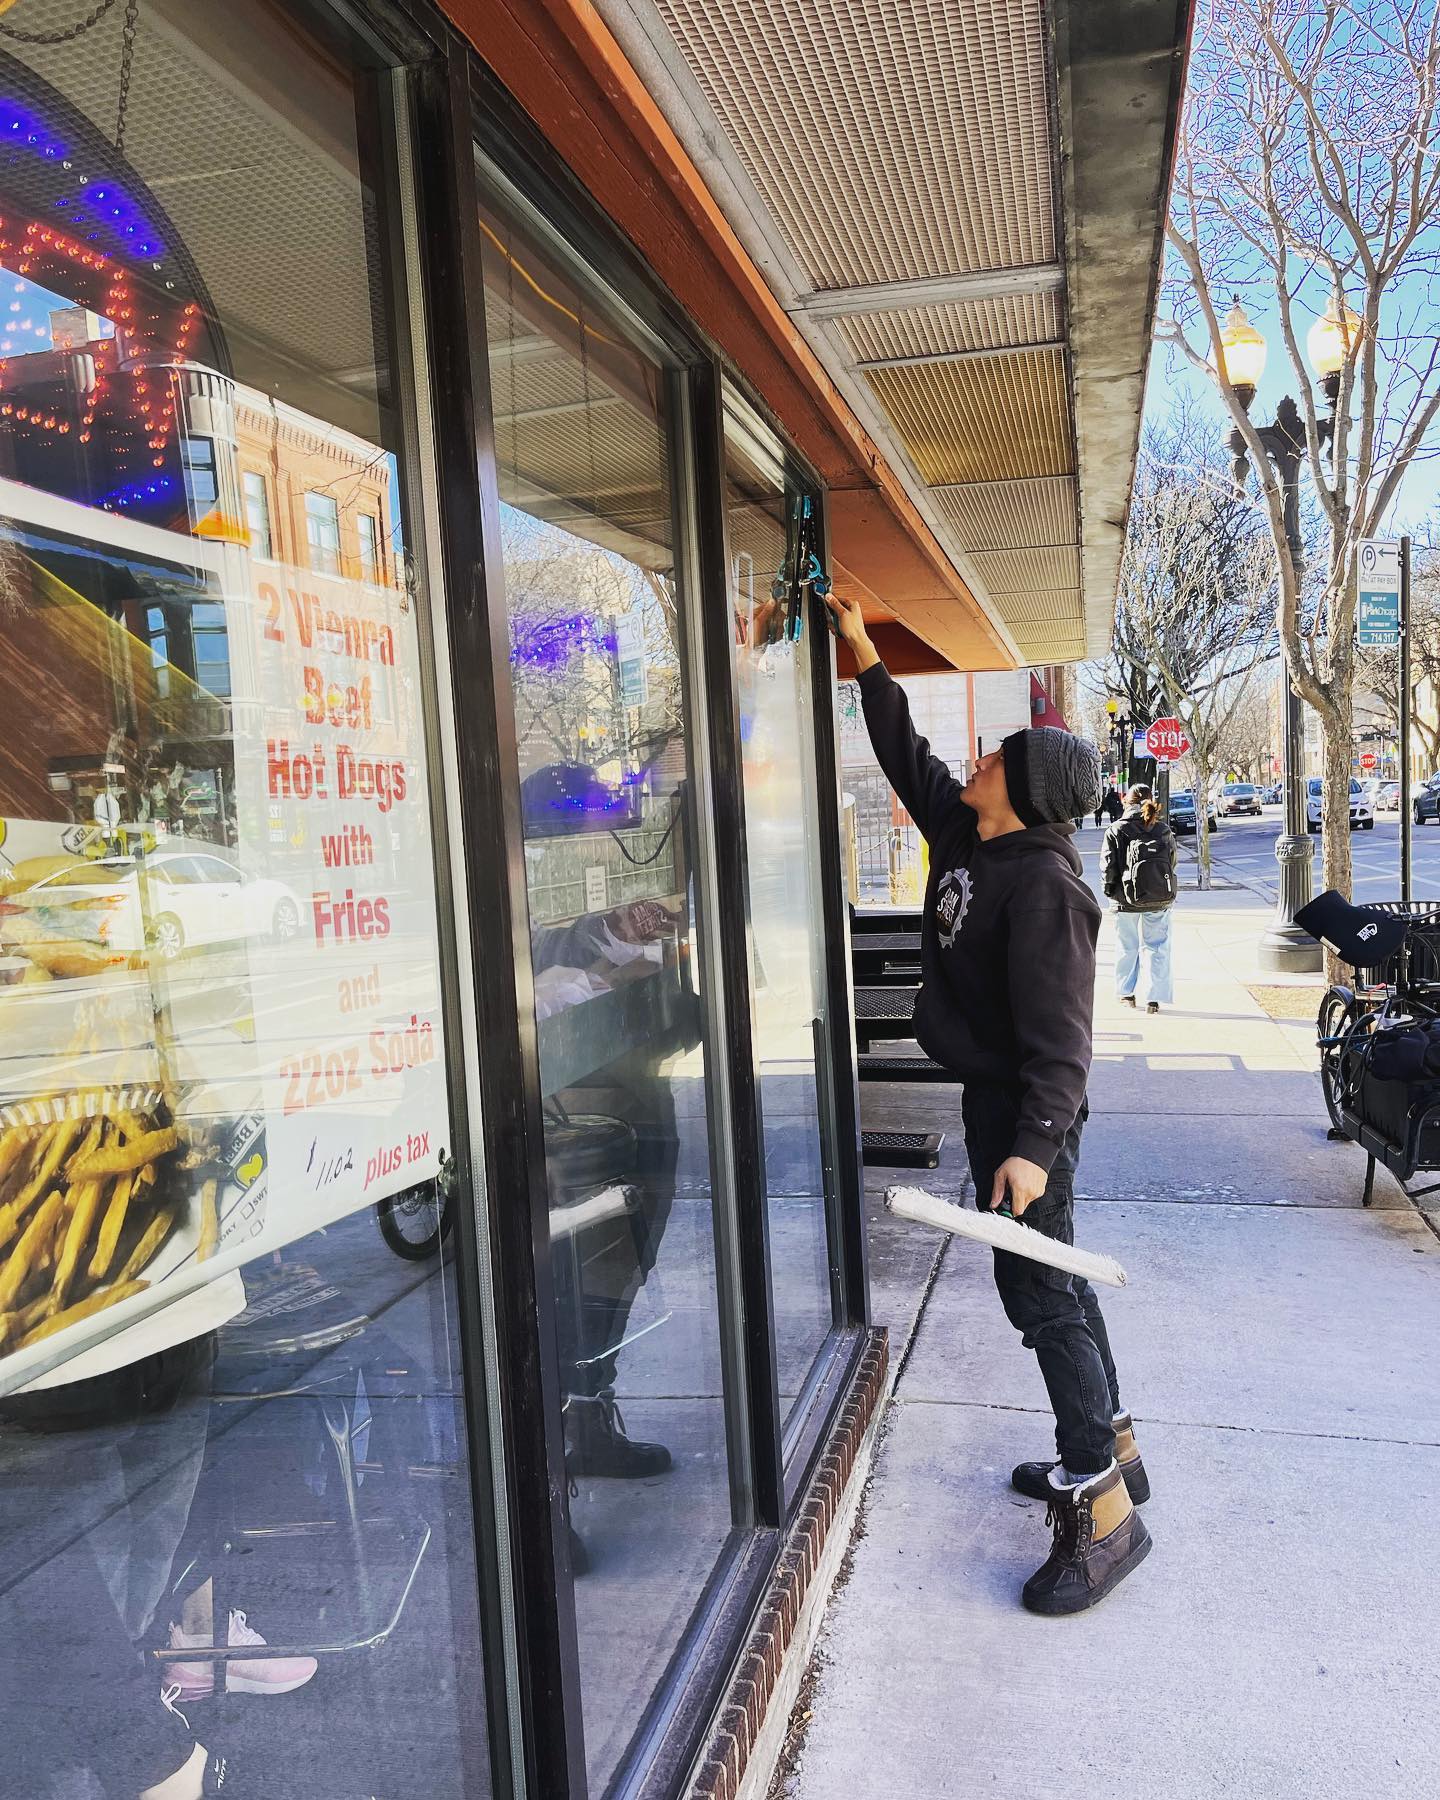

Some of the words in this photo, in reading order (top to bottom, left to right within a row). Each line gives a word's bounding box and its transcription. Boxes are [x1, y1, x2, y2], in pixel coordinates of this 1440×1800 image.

[258, 581, 286, 644] 2
[288, 587, 395, 667] Vienna
[303, 666, 372, 730] Beef
[1149, 731, 1187, 748] STOP
[1360, 757, 1376, 766] STOP
[266, 738, 328, 800] Hot
[336, 744, 407, 813] Dogs
[321, 824, 374, 868] with
[312, 888, 391, 948] Fries
[338, 963, 382, 1014] and
[279, 1042, 363, 1116] 22oz
[369, 1014, 435, 1074] Soda
[362, 1145, 402, 1191] plus
[406, 1130, 430, 1164] tax
